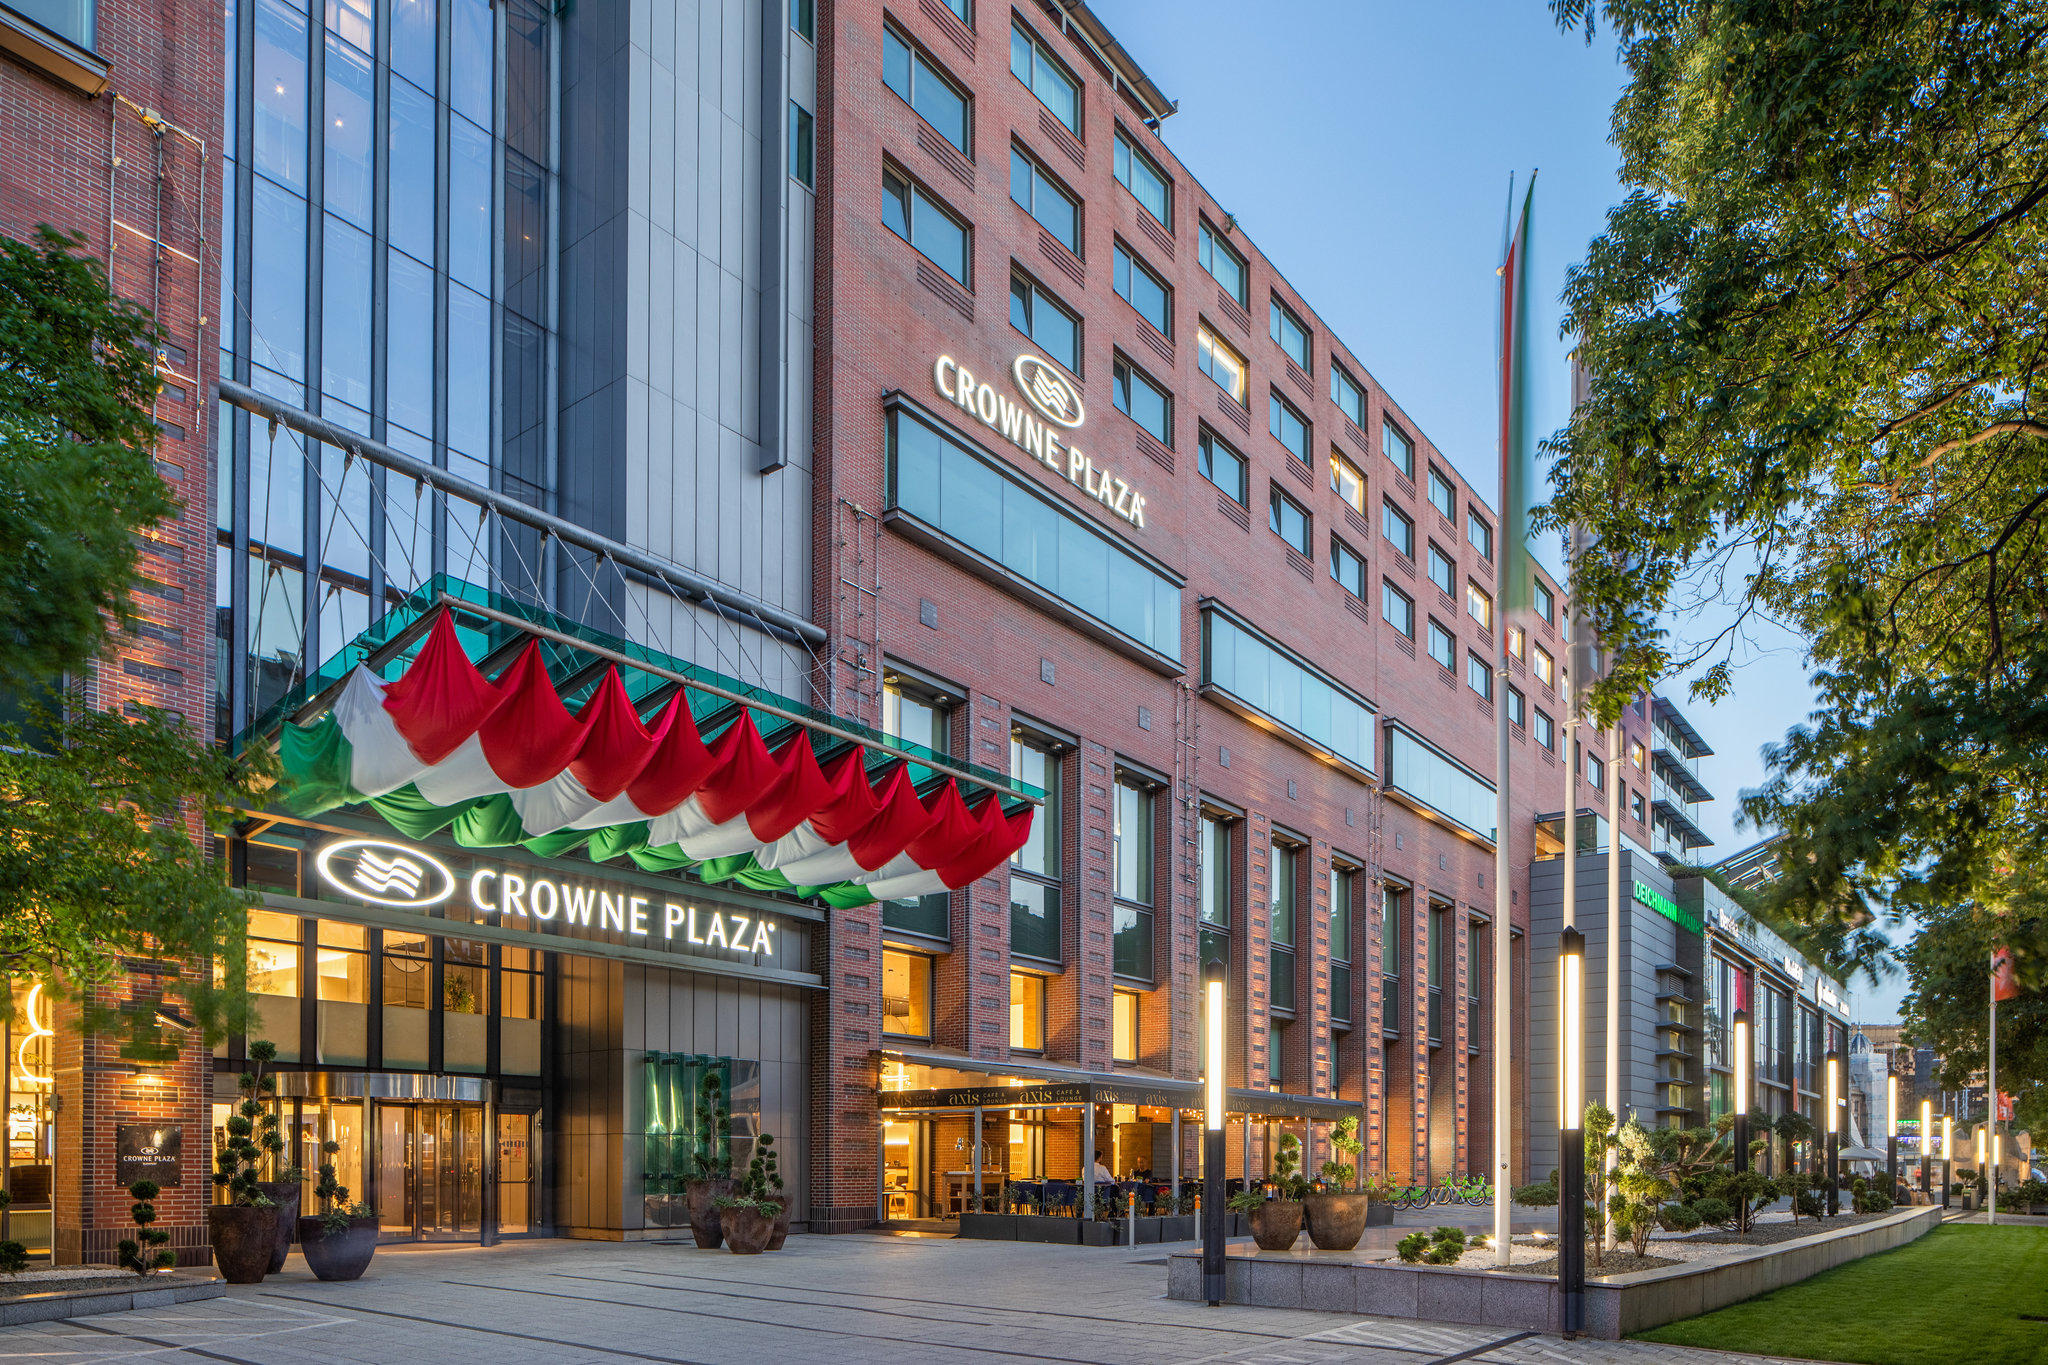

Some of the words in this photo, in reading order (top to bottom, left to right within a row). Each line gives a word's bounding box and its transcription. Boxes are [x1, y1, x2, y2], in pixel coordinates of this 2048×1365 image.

[934, 354, 1059, 470] CROWNE
[1069, 446, 1145, 529] PLAZA
[1635, 879, 1678, 923] DEICHMANN
[471, 869, 648, 935] CROWNE
[664, 903, 775, 955] PLAZA
[949, 1089, 980, 1107] axis
[1019, 1086, 1053, 1104] axis
[1095, 1086, 1120, 1103] axis
[1146, 1089, 1168, 1106] axis
